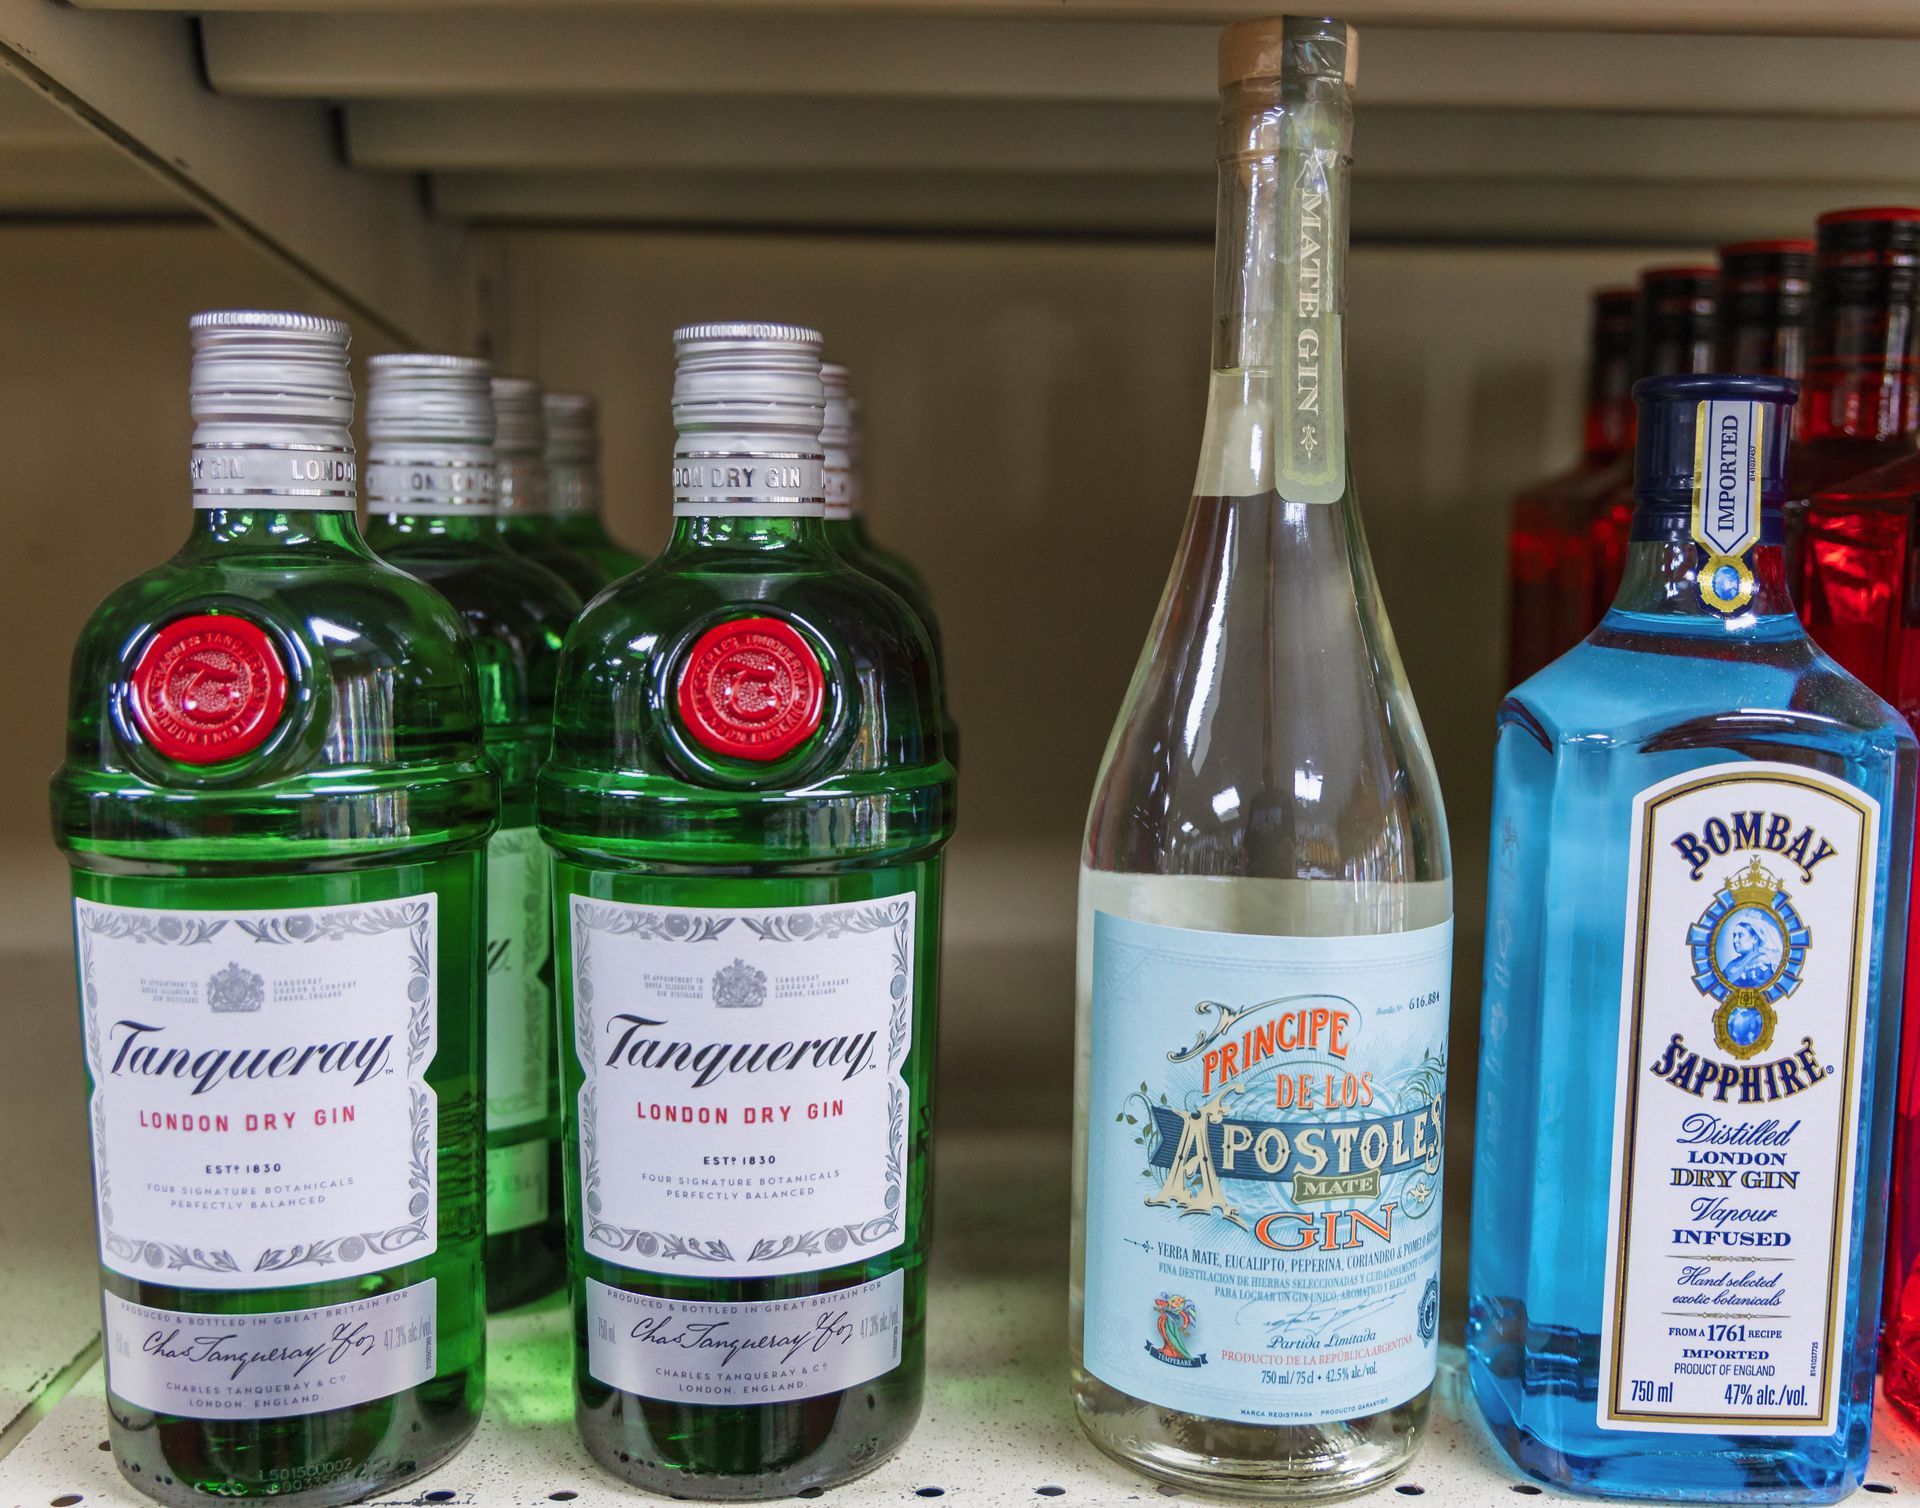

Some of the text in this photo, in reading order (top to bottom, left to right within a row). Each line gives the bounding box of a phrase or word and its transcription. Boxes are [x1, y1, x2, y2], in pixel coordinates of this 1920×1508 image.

[1297, 190, 1321, 416] MATE GIN
[210, 458, 244, 479] GIN
[711, 467, 755, 488] DRY
[765, 466, 800, 488] GIN
[1718, 414, 1739, 533] IMPORTED
[1671, 810, 1838, 884] BOMBAY
[110, 1019, 393, 1096] Tanqueray
[605, 1013, 877, 1089] Tanqueray
[1202, 1008, 1351, 1097] PRINCIPE
[1650, 1032, 1826, 1104] SAPPHIRE
[1275, 1071, 1374, 1110] DE LOS
[139, 1105, 356, 1133] LONDON DRY GIN
[637, 1099, 844, 1125] LONDON DRY GIN
[1676, 1112, 1802, 1146] Distilled
[246, 1163, 282, 1175] 1830
[742, 1154, 776, 1166] 1830
[1144, 1083, 1443, 1233] APOSTOLES
[1688, 1150, 1788, 1166] LONDON
[147, 1176, 355, 1197] FOUR SIGNATURE BOTANICALS
[642, 1169, 841, 1187] FOUR SIGNATURE BOTANICALS
[1302, 1175, 1374, 1196] MATE
[1670, 1168, 1801, 1190] DRY GIN
[170, 1195, 326, 1210] PERFECTLY BALANCED
[666, 1187, 815, 1200] PERFECTLY BALANCED
[1690, 1196, 1778, 1229] Vapour
[1254, 1202, 1399, 1252] GIN
[1671, 1229, 1792, 1248] INFUSED
[1158, 1241, 1189, 1262] YERBA
[1192, 1248, 1222, 1268] MATE,
[1225, 1254, 1288, 1273] EUCALIPTO,
[1347, 1247, 1395, 1270] CORIANDRO
[1396, 1247, 1402, 1260] &
[1158, 1261, 1178, 1276] FINA
[1179, 1266, 1235, 1286] DESTILACION
[1237, 1275, 1249, 1287] DE
[1251, 1276, 1290, 1289] HIERBAS
[1292, 1273, 1359, 1289] SELECCIONADAS
[1359, 1273, 1366, 1282] Y
[1677, 1265, 1784, 1289] Hand selected
[607, 1281, 883, 1314] PRODUCED & BOTTLED IN GREAT BRITAIN FOR
[1214, 1286, 1237, 1300] PARA
[1239, 1288, 1276, 1302] LOGRAR
[1276, 1291, 1290, 1303] UN
[1292, 1290, 1312, 1303] GIN
[1383, 1281, 1390, 1292] Y
[1389, 1272, 1417, 1290] ELEGANTE
[1672, 1288, 1785, 1307] exotic botanicals
[120, 1290, 409, 1328] PRODUCED & BOTTLED IN GREAT BRITAIN FOR
[1266, 1328, 1377, 1350] Partida Limitada
[1668, 1324, 1782, 1342] FROM A 1761 RECIPE
[189, 1333, 325, 1381] Tanqueray
[680, 1322, 814, 1369] Tanqueray
[1221, 1349, 1284, 1366] PRODUCTO
[1286, 1355, 1301, 1366] DE
[1303, 1355, 1317, 1366] LA
[1371, 1333, 1414, 1357] ARGENTINA
[1682, 1348, 1770, 1361] IMPORTED
[655, 1367, 711, 1381] CHARLES
[717, 1368, 796, 1381] TANQUERAY
[802, 1367, 808, 1375] &
[1261, 1369, 1277, 1385] 750
[1325, 1367, 1350, 1383] 42.5%
[1674, 1363, 1776, 1377] PRODUCT OF ENGLAND
[166, 1381, 221, 1395] CHARLES
[226, 1381, 311, 1395] TANQUERAY
[317, 1379, 324, 1387] &
[1631, 1380, 1674, 1403] 750 ml
[1724, 1384, 1808, 1407] 47% alc./vol.
[1240, 1409, 1266, 1418] MARCA
[1320, 1406, 1356, 1416] PRODUCTO
